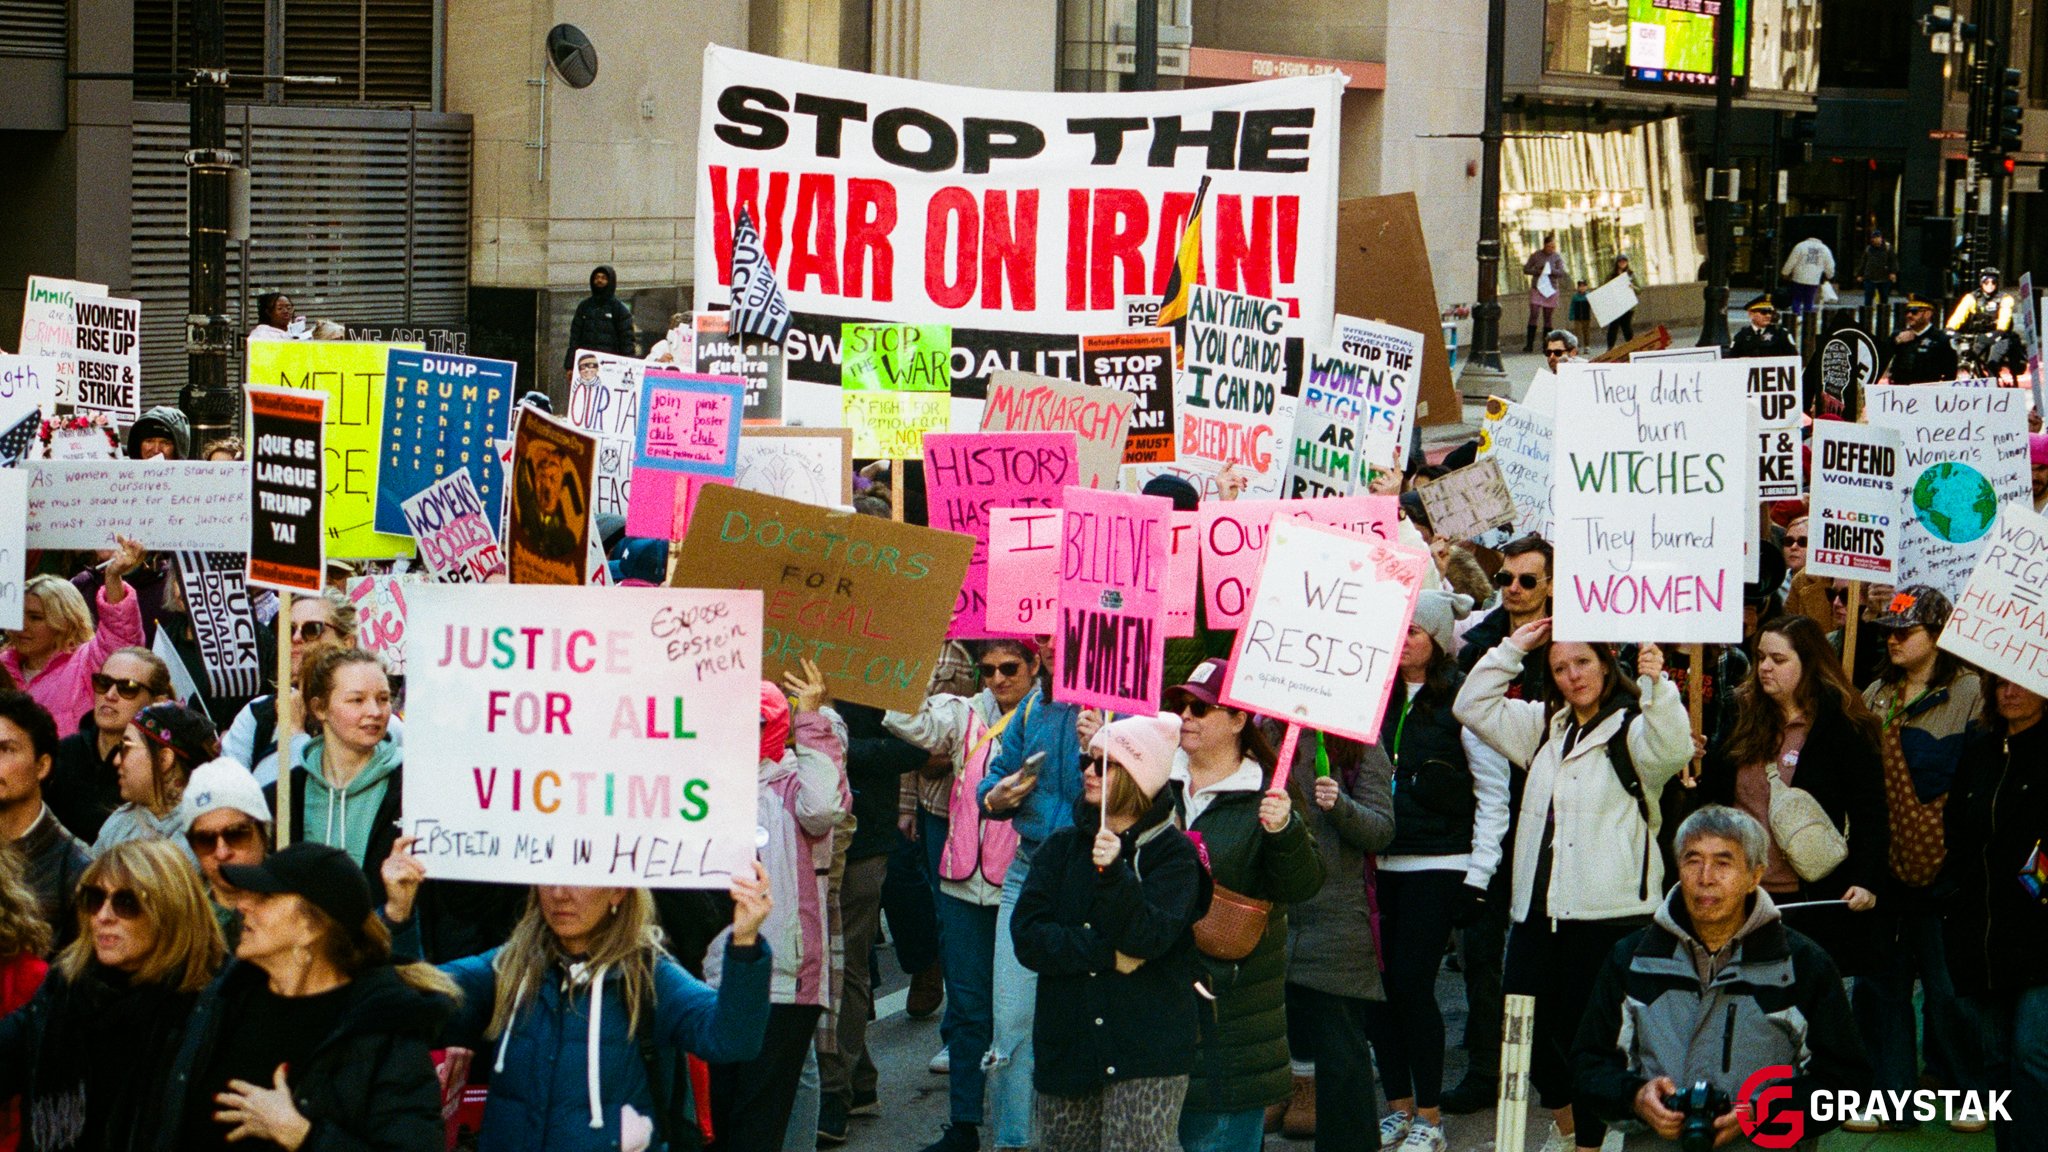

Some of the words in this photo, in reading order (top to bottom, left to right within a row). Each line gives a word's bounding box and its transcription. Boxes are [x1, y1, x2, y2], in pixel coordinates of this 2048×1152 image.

[714, 85, 1045, 173] STOP
[1066, 107, 1315, 173] THE
[708, 165, 898, 302] WAR
[924, 185, 1040, 312] ON
[1066, 187, 1302, 318] IRAN!
[75, 302, 136, 332] WOMEN
[1188, 287, 1283, 336] ANYTHING
[76, 327, 110, 353] RISE
[113, 332, 136, 356] UP
[429, 330, 467, 356] THE
[745, 344, 758, 356] a
[761, 341, 779, 356] la
[851, 326, 921, 353] STOP
[1088, 336, 1165, 348] RefuseFascism.org
[1191, 325, 1227, 367] YOU
[1232, 331, 1261, 372] CAN
[1262, 341, 1281, 376] DO
[78, 360, 119, 383] RESIST
[122, 366, 134, 384] &
[422, 358, 478, 379] DUMP
[708, 359, 769, 375] guerra
[847, 356, 878, 378] THE
[881, 350, 949, 387] WAR
[1094, 355, 1162, 375] STOP
[1309, 353, 1406, 406] WOMEN'S
[78, 380, 134, 408] STRIKE
[1099, 374, 1158, 392] WAR
[1186, 365, 1212, 409] I
[1214, 373, 1251, 414] CAN
[1253, 382, 1276, 416] DO
[1584, 369, 1638, 417] They
[1650, 369, 1703, 403] didn't
[571, 383, 611, 431] OUR
[651, 393, 681, 411] join
[651, 411, 671, 424] the
[696, 399, 719, 416] pink
[982, 385, 1133, 448] MATRIARCHY
[1760, 394, 1796, 421] UP
[1875, 390, 1920, 415] The
[1935, 391, 2010, 414] World
[649, 426, 675, 441] club
[690, 429, 715, 444] club
[694, 415, 725, 433] poster
[1637, 403, 1687, 443] burn
[1916, 420, 1986, 443] needs
[258, 433, 292, 457] ¡QUE
[294, 439, 316, 461] SE
[1125, 451, 1158, 463] NOW!
[1136, 438, 1170, 449] MUST
[1182, 412, 1274, 474] BLEEDING
[1822, 439, 1895, 477] DEFEND
[1905, 447, 1982, 468] Women's
[65, 470, 109, 483] women
[118, 470, 135, 480] we
[143, 466, 176, 478] must
[220, 468, 235, 479] up
[256, 461, 317, 490] LARGUE
[930, 446, 1069, 487] HISTORY
[1569, 450, 1725, 495] WITCHES
[1822, 473, 1894, 491] WOMEN'S
[51, 498, 81, 508] must
[171, 493, 201, 506] EACH
[259, 490, 312, 517] TRUMP
[50, 518, 85, 529] must
[96, 515, 133, 528] stand
[168, 514, 185, 526] for
[271, 520, 296, 546] YA!
[1822, 508, 1834, 519] &
[1837, 510, 1890, 527] LGBTQ
[421, 512, 493, 571] BODIES
[720, 511, 935, 580] DOCTORS
[1009, 515, 1056, 553] I
[1572, 516, 1636, 573] They
[1651, 513, 1715, 550] burned
[1823, 522, 1885, 556] RIGHTS
[467, 545, 500, 583] NOT
[1064, 511, 1158, 593] BELIEVE
[780, 565, 855, 597] FOR
[1304, 570, 1364, 616] WE
[1573, 568, 1725, 615] WOMEN
[186, 573, 220, 667] TRUMP
[206, 574, 235, 667] DONALD
[223, 571, 257, 670] FUCK
[651, 600, 729, 638] Expose
[438, 624, 635, 675] JUSTICE
[1062, 606, 1153, 702] WOMEN
[1245, 619, 1390, 683] RESIST
[487, 691, 573, 735] FOR
[609, 696, 697, 739] ALL
[473, 767, 711, 823] VICTIMS
[513, 833, 555, 865] MEN
[572, 839, 593, 866] IN
[608, 832, 732, 879] HELL
